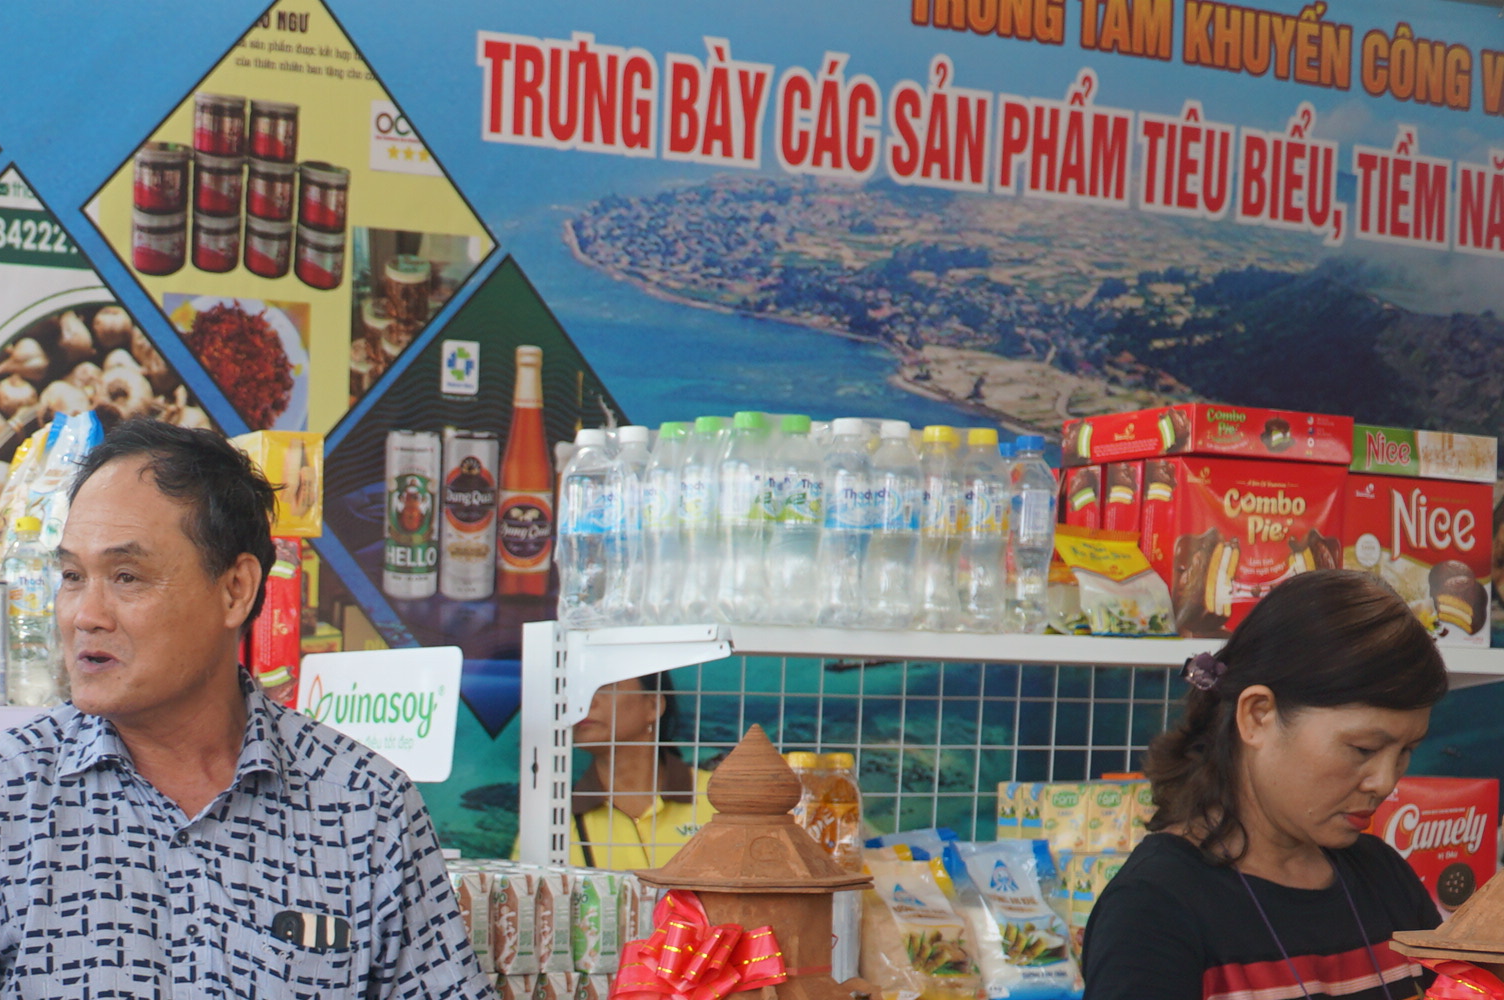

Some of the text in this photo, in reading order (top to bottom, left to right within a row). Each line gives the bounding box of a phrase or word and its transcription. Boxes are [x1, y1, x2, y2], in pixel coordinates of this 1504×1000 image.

[1183, 2, 1352, 91] KHUYẾN
[1361, 23, 1472, 111] CÔNG
[376, 112, 411, 136] OC
[484, 38, 1504, 252] TRƯNG BÀY CÁC SẢN PHẨM TIÊU BIỂU, TIỀM NĂ
[1206, 408, 1247, 424] Combo
[1365, 430, 1411, 469] Nice
[1224, 488, 1306, 516] Combo
[1248, 515, 1283, 544] Pie
[1390, 487, 1476, 562] Nice
[386, 545, 437, 568] HELLO
[1385, 803, 1488, 861] Camely
